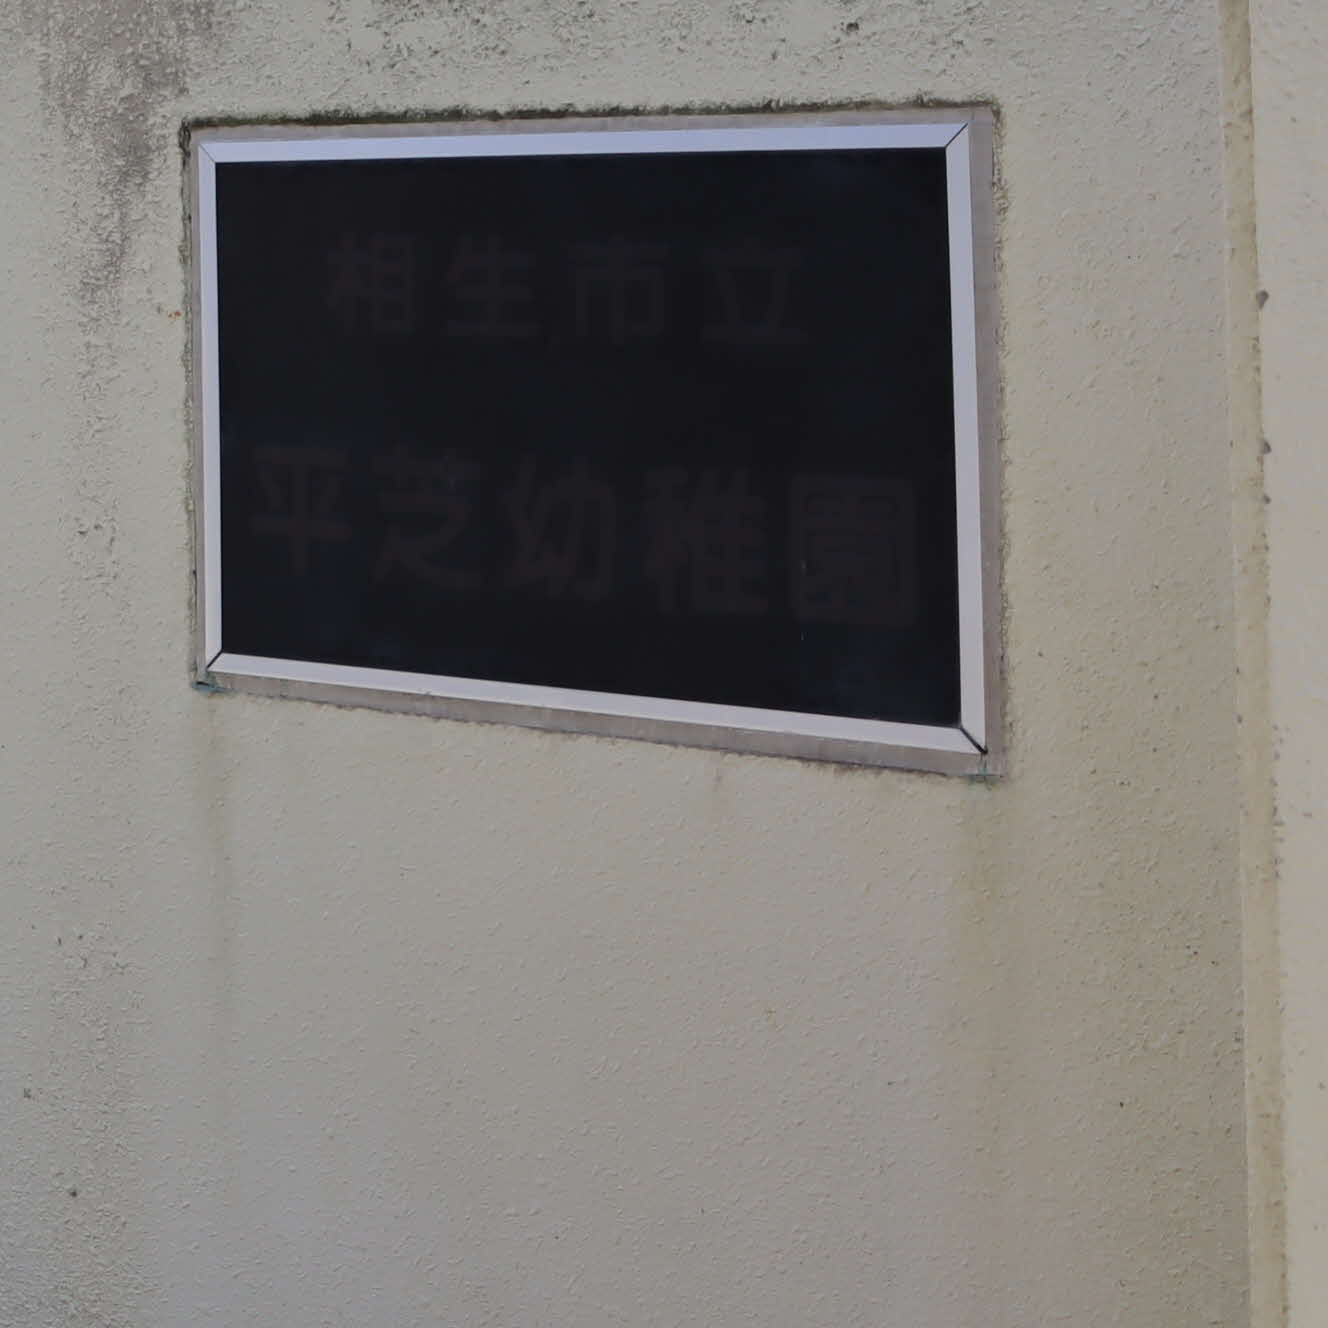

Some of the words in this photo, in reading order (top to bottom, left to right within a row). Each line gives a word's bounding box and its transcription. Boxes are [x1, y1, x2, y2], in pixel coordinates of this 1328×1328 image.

[324, 229, 809, 346] 相生市立
[250, 442, 918, 629] 平芝幼稚園
